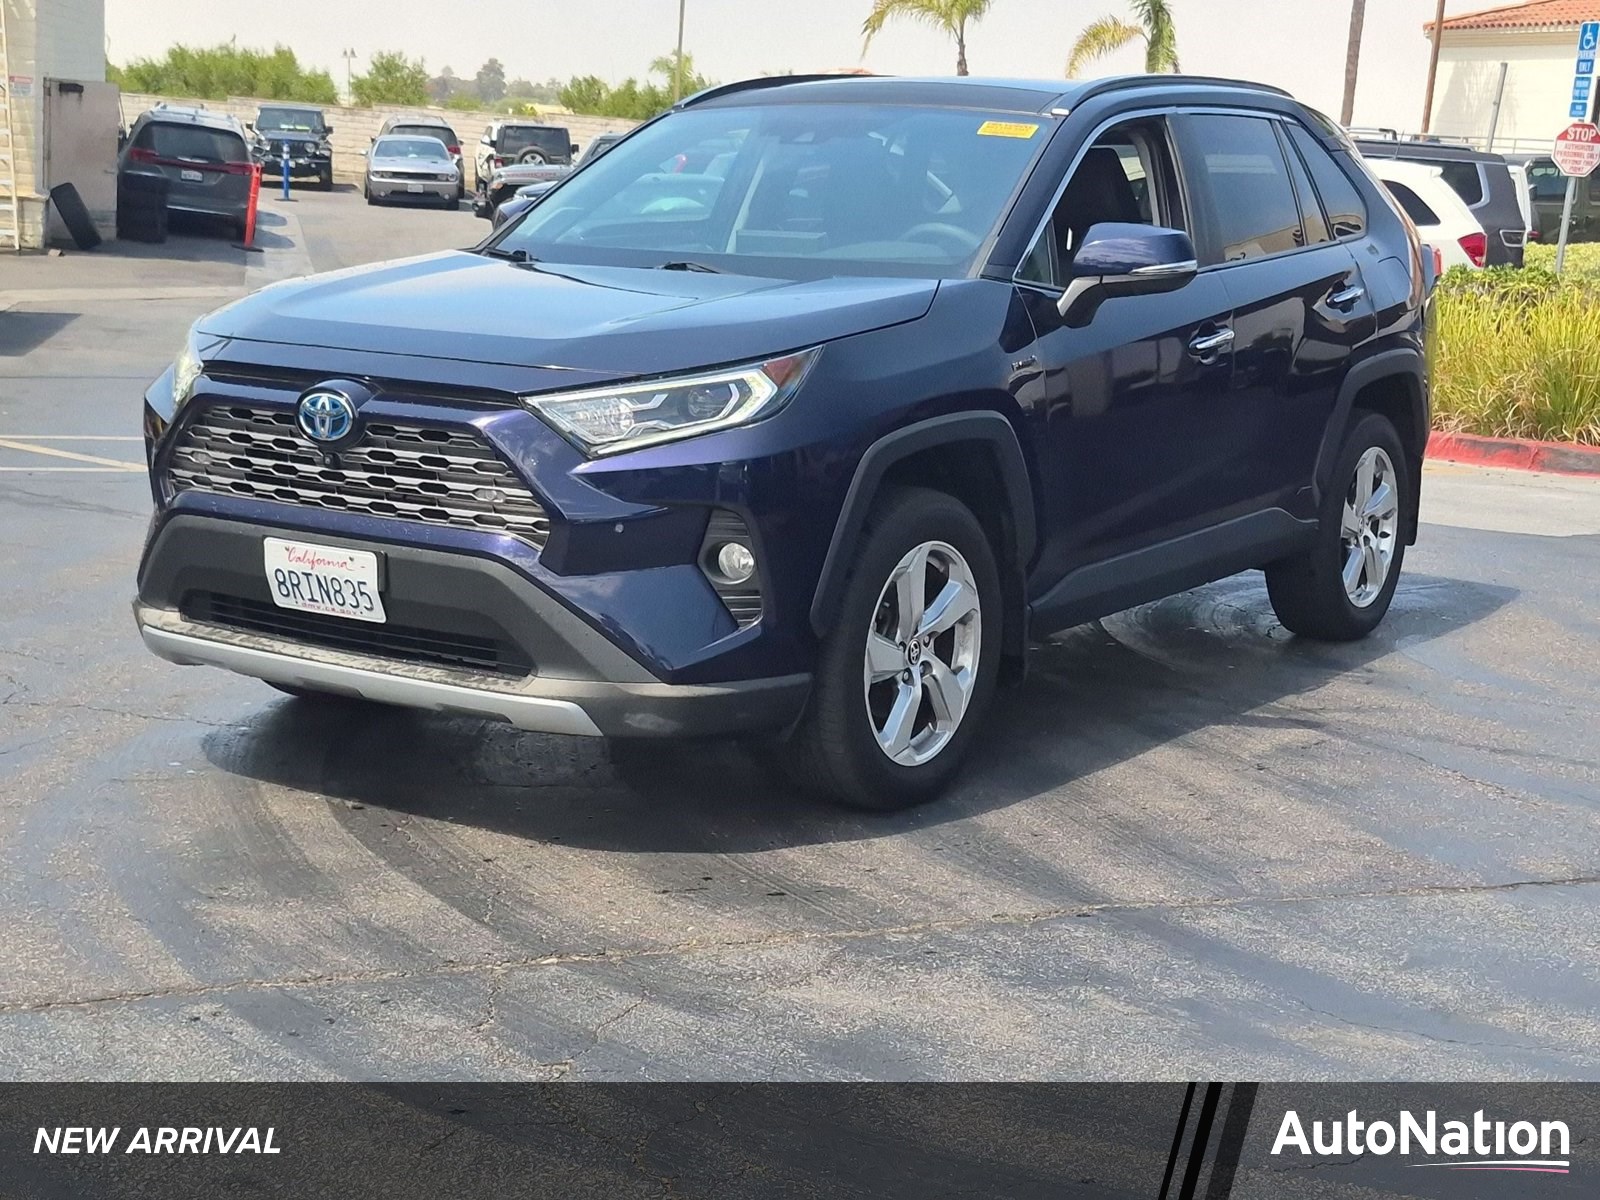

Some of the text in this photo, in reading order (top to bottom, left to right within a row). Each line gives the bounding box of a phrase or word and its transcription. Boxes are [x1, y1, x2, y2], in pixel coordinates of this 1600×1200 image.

[1567, 127, 1596, 141] STOP
[286, 546, 356, 571] California
[274, 567, 375, 612] 8RIN835
